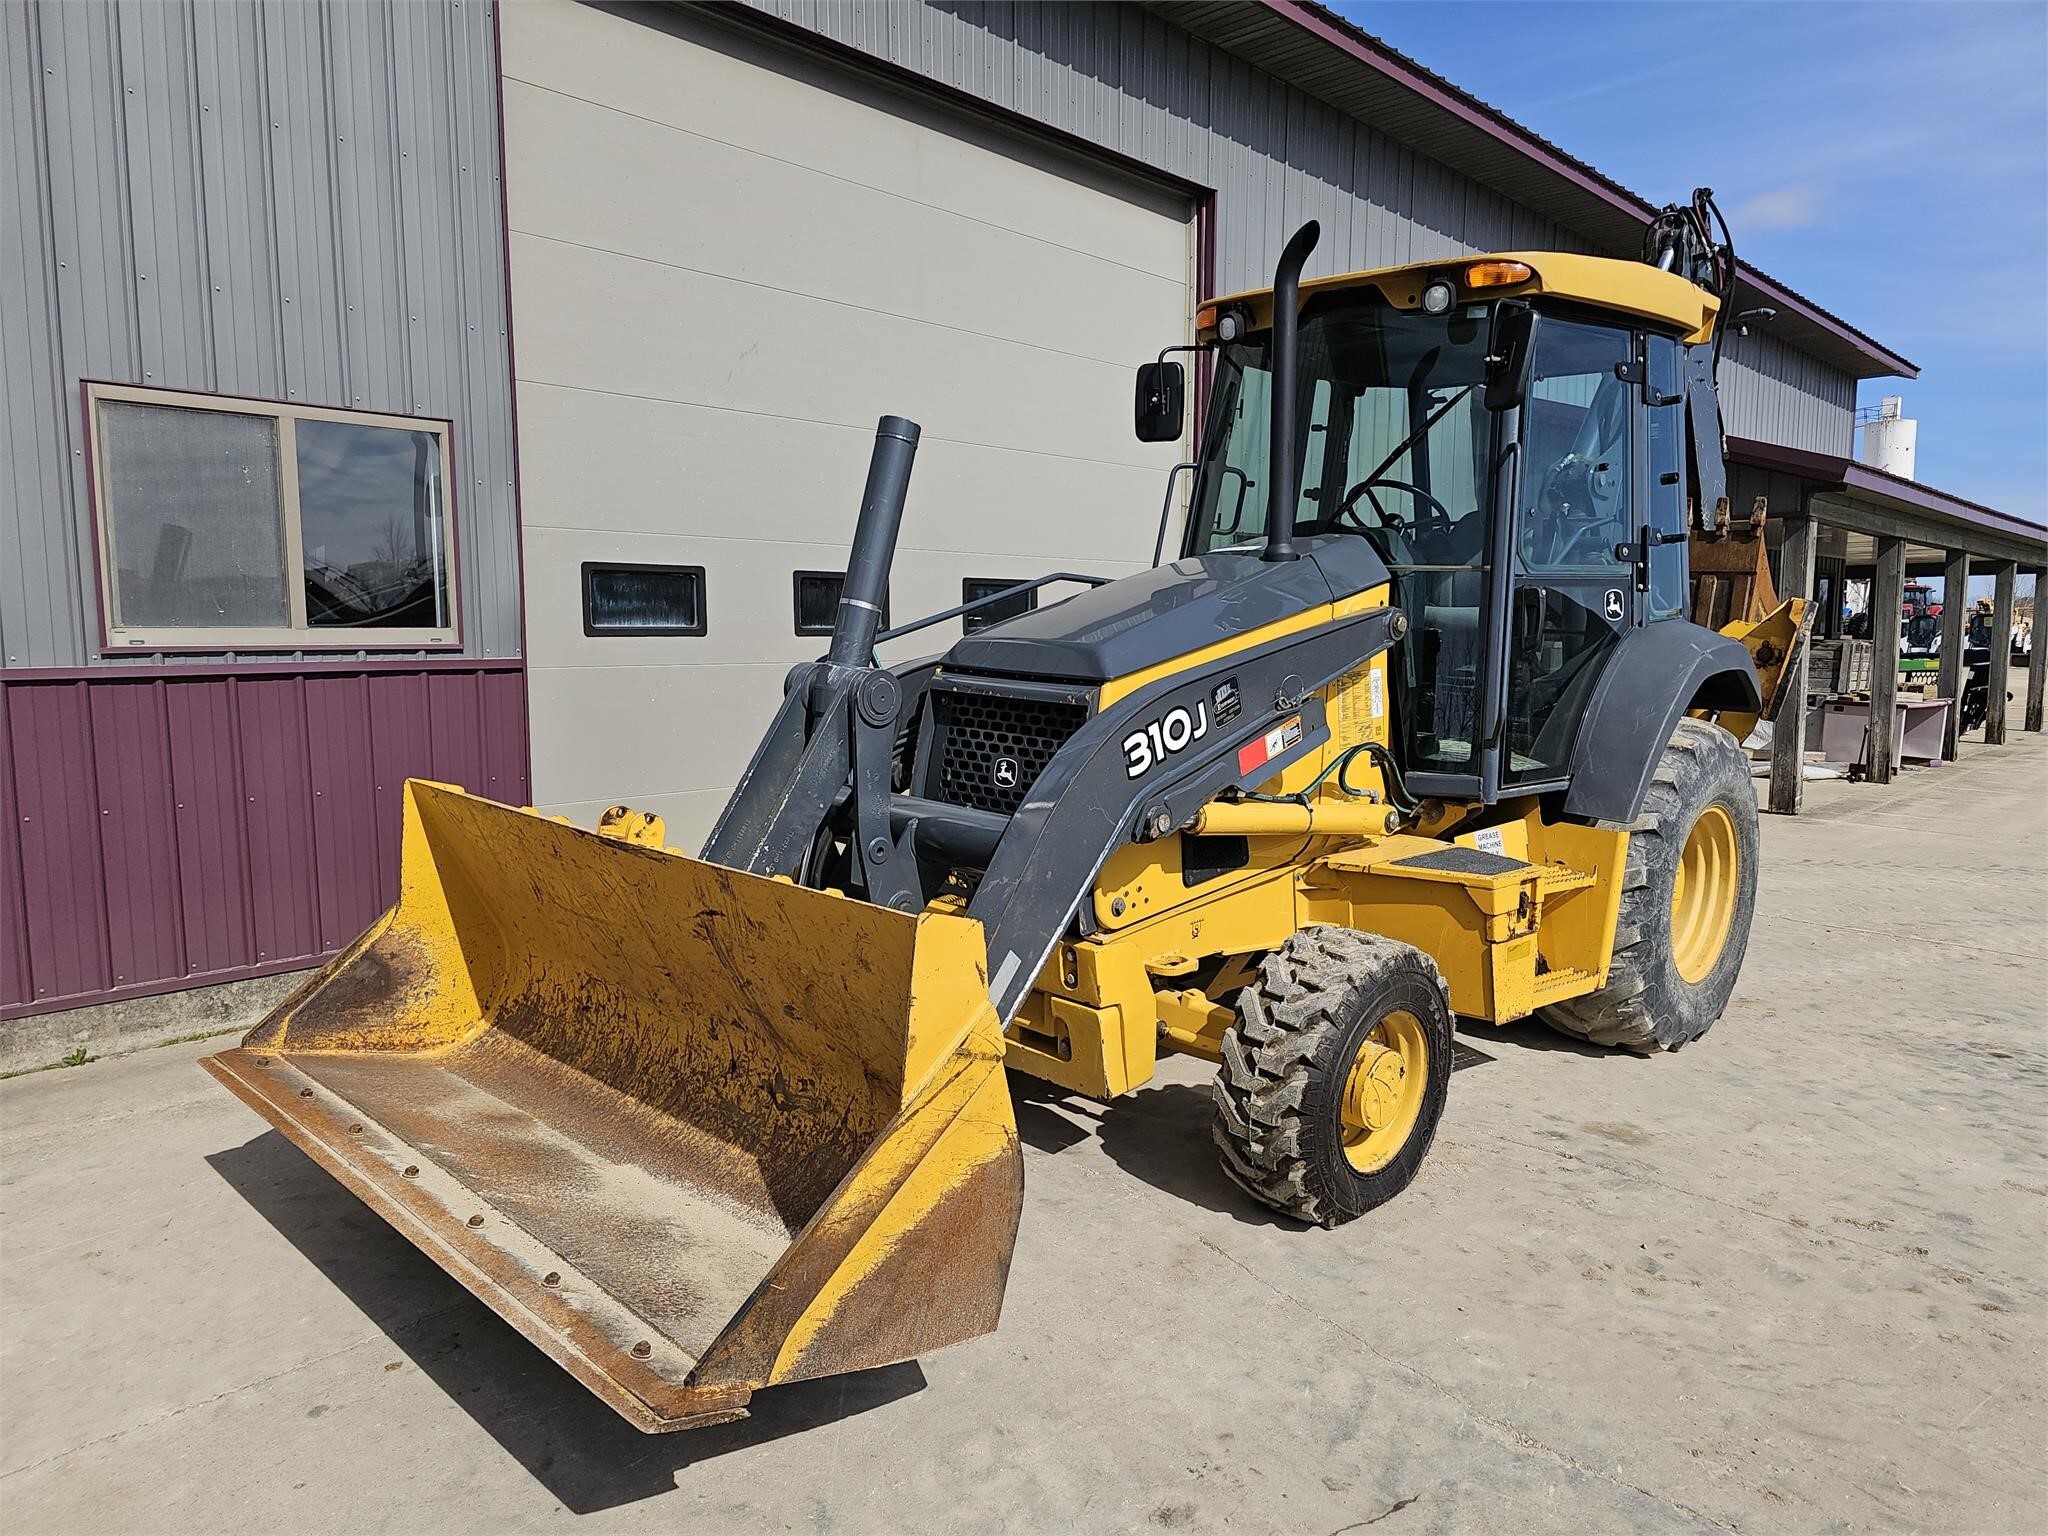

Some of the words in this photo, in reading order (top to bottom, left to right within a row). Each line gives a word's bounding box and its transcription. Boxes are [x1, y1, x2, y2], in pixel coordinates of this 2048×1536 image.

[1122, 699, 1208, 779] 310J
[1477, 831, 1500, 841] GREASE
[1477, 840, 1502, 850] MACHINE
